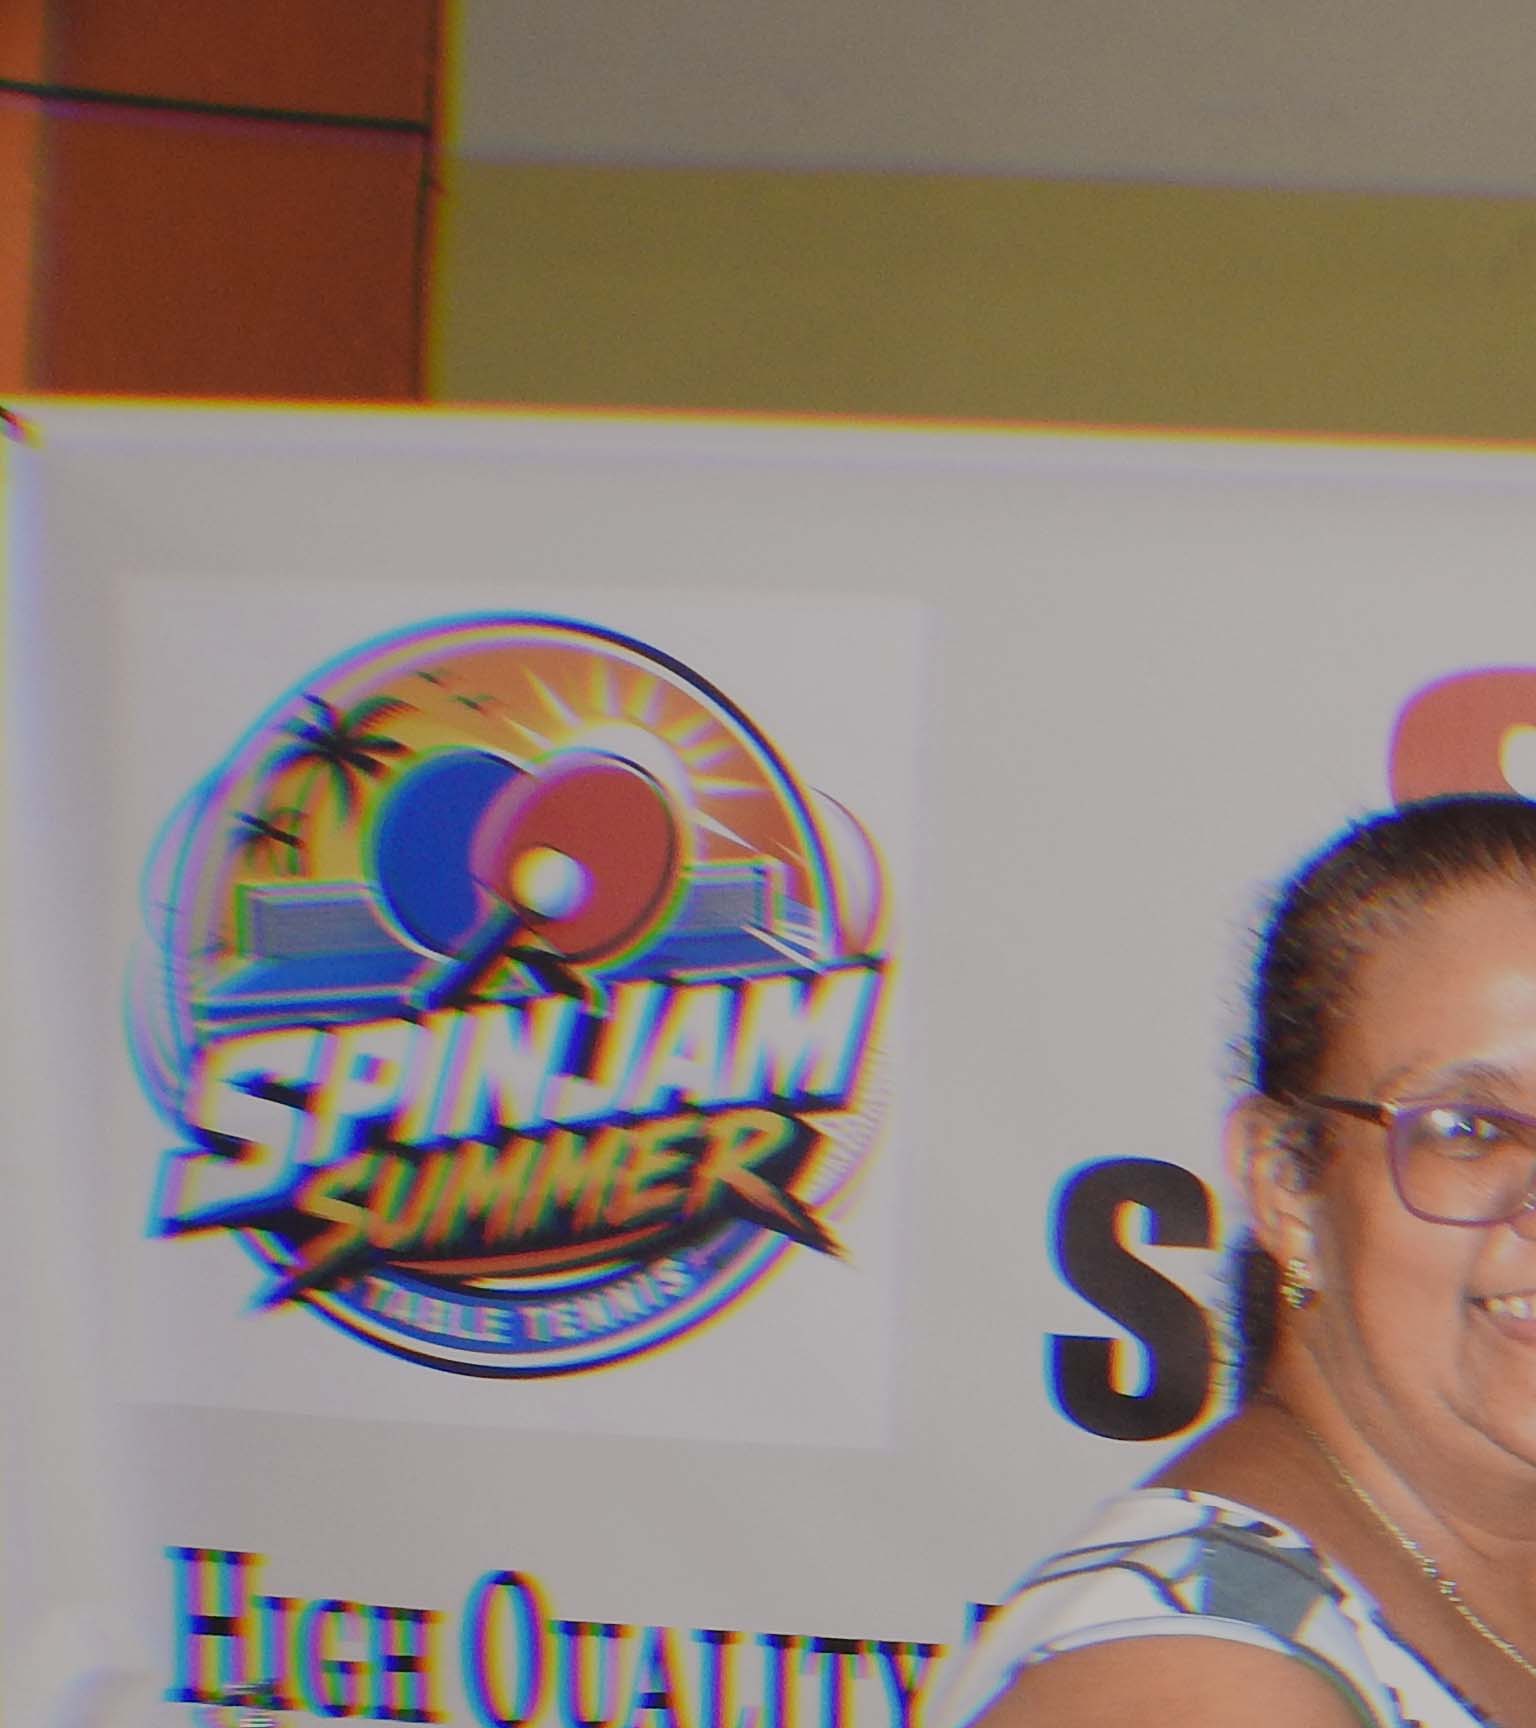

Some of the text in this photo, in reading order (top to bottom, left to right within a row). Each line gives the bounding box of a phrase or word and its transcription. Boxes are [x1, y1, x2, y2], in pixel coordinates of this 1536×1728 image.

[148, 962, 888, 1234] SPINJAM
[272, 1108, 838, 1288] SUMMER
[365, 1257, 694, 1343] TABLE TENNIS
[163, 1545, 446, 1723] HIGH
